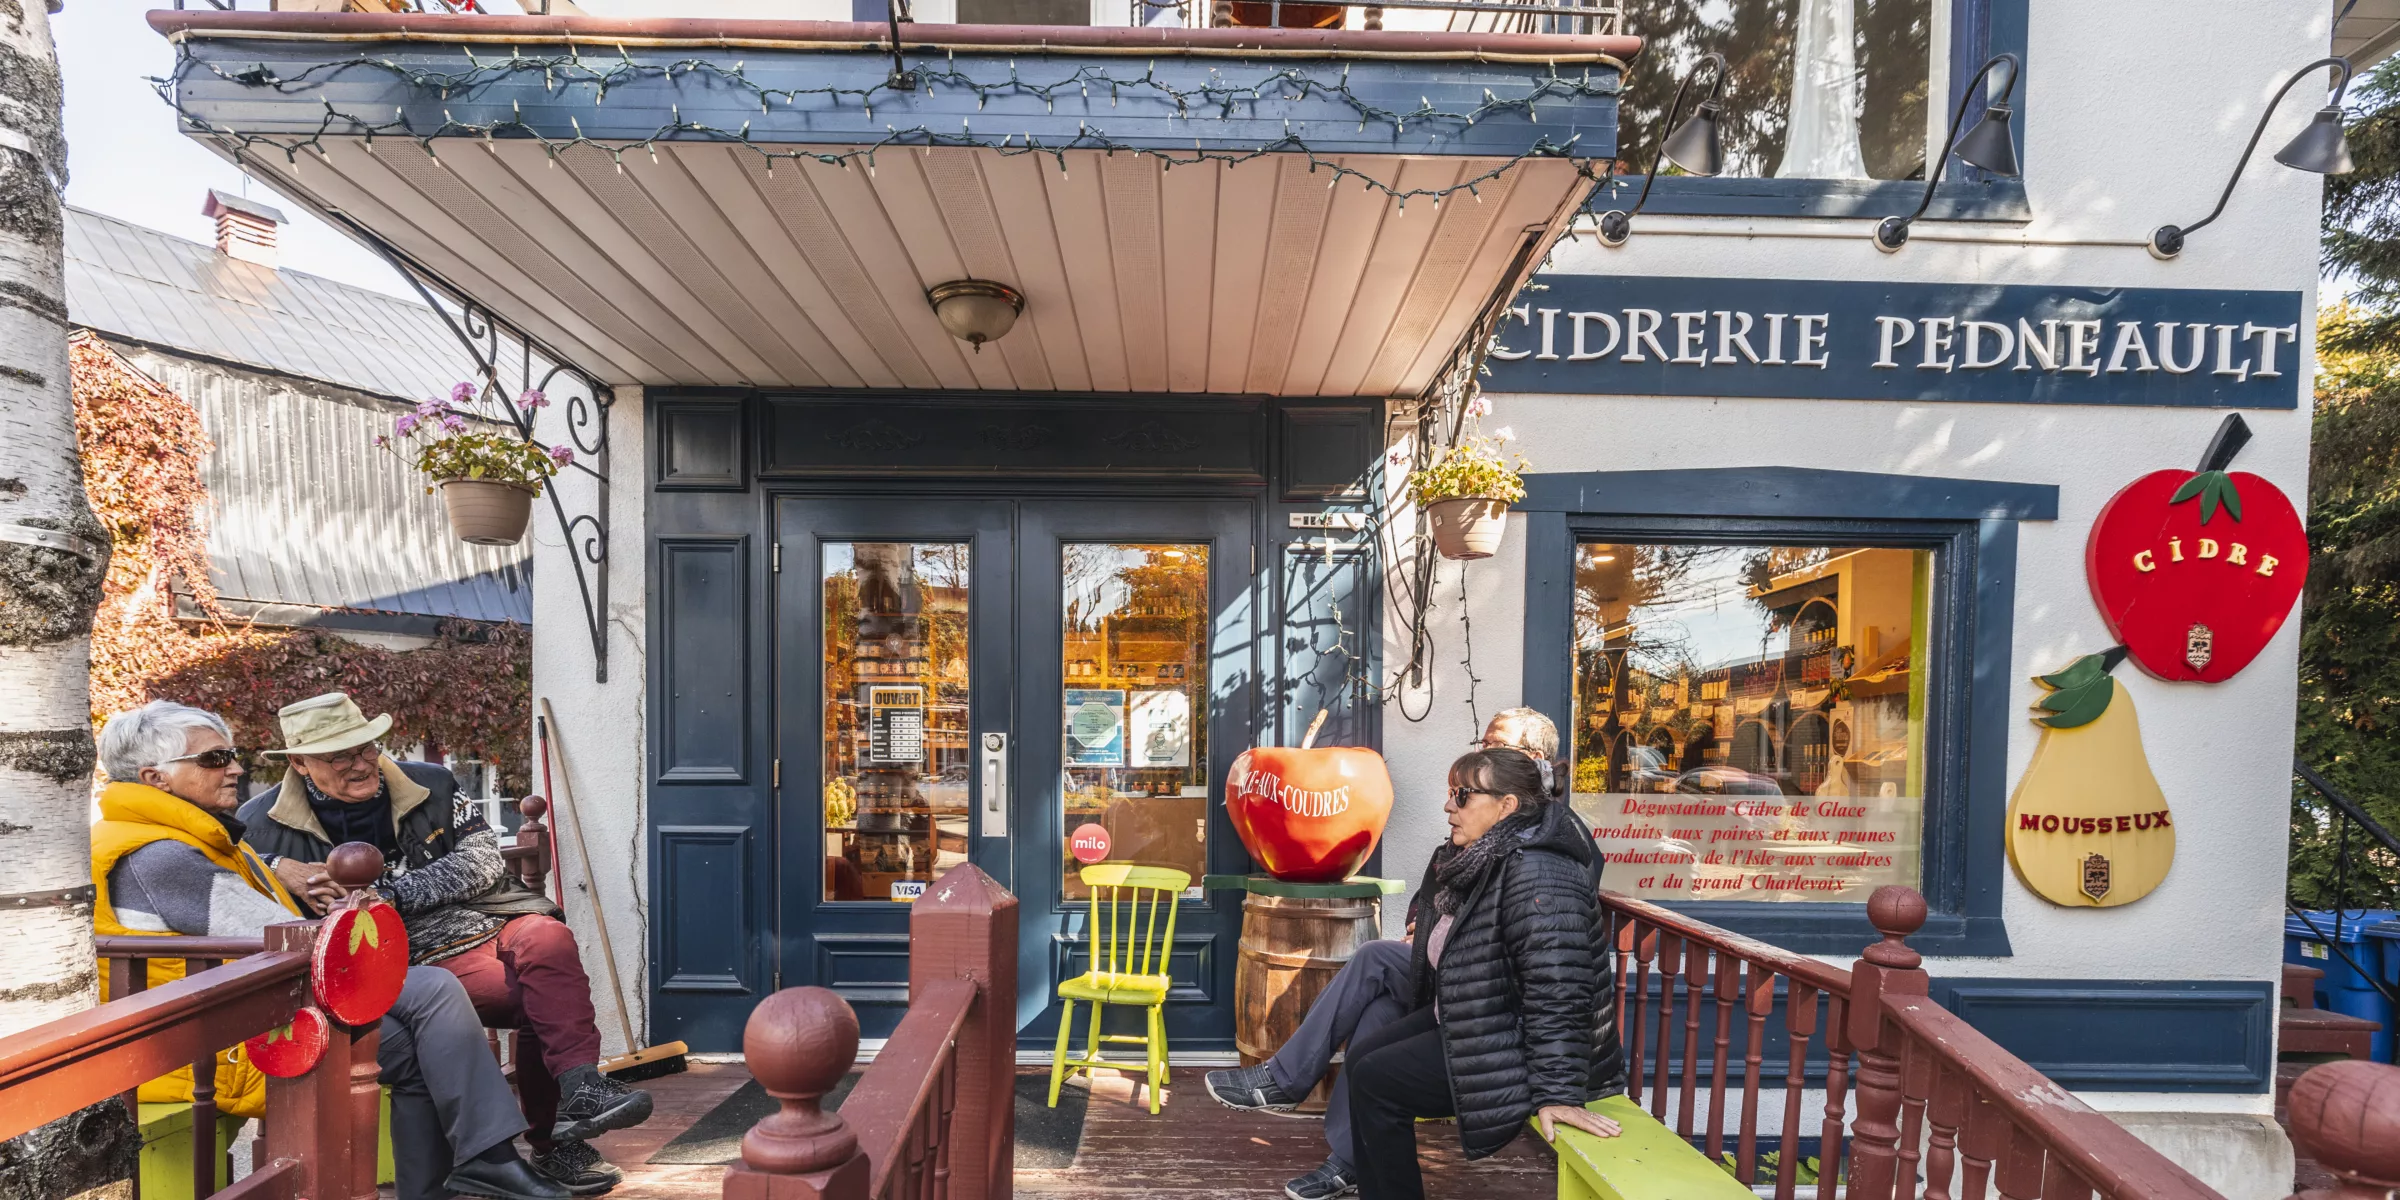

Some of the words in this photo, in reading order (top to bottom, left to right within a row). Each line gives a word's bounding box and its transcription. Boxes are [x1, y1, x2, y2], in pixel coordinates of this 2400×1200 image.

[1486, 303, 1829, 370] CIDRERIE
[1872, 315, 2297, 382] PEDNEAULT
[2133, 536, 2279, 577] CIDRE
[874, 692, 919, 705] OUVERT
[1622, 798, 1726, 818] Dégustation
[1734, 800, 1782, 817] Cidre
[1790, 801, 1810, 817] de
[1818, 801, 1866, 818] Glace
[2019, 810, 2170, 834] MOUSSEUX
[1075, 836, 1106, 850] milo
[1592, 823, 1663, 841] produits
[1671, 829, 1703, 840] aux
[1710, 825, 1765, 844] poires
[1773, 828, 1790, 841] et
[1797, 830, 1830, 842] aux
[1836, 830, 1896, 845] prunes
[1601, 848, 1696, 865] roducteurs
[1704, 849, 1724, 865] de
[895, 885, 922, 895] VISA
[1638, 875, 1655, 888] et
[1663, 873, 1683, 889] du
[1691, 873, 1743, 892] grand
[1751, 874, 1845, 891] Charlevoix
